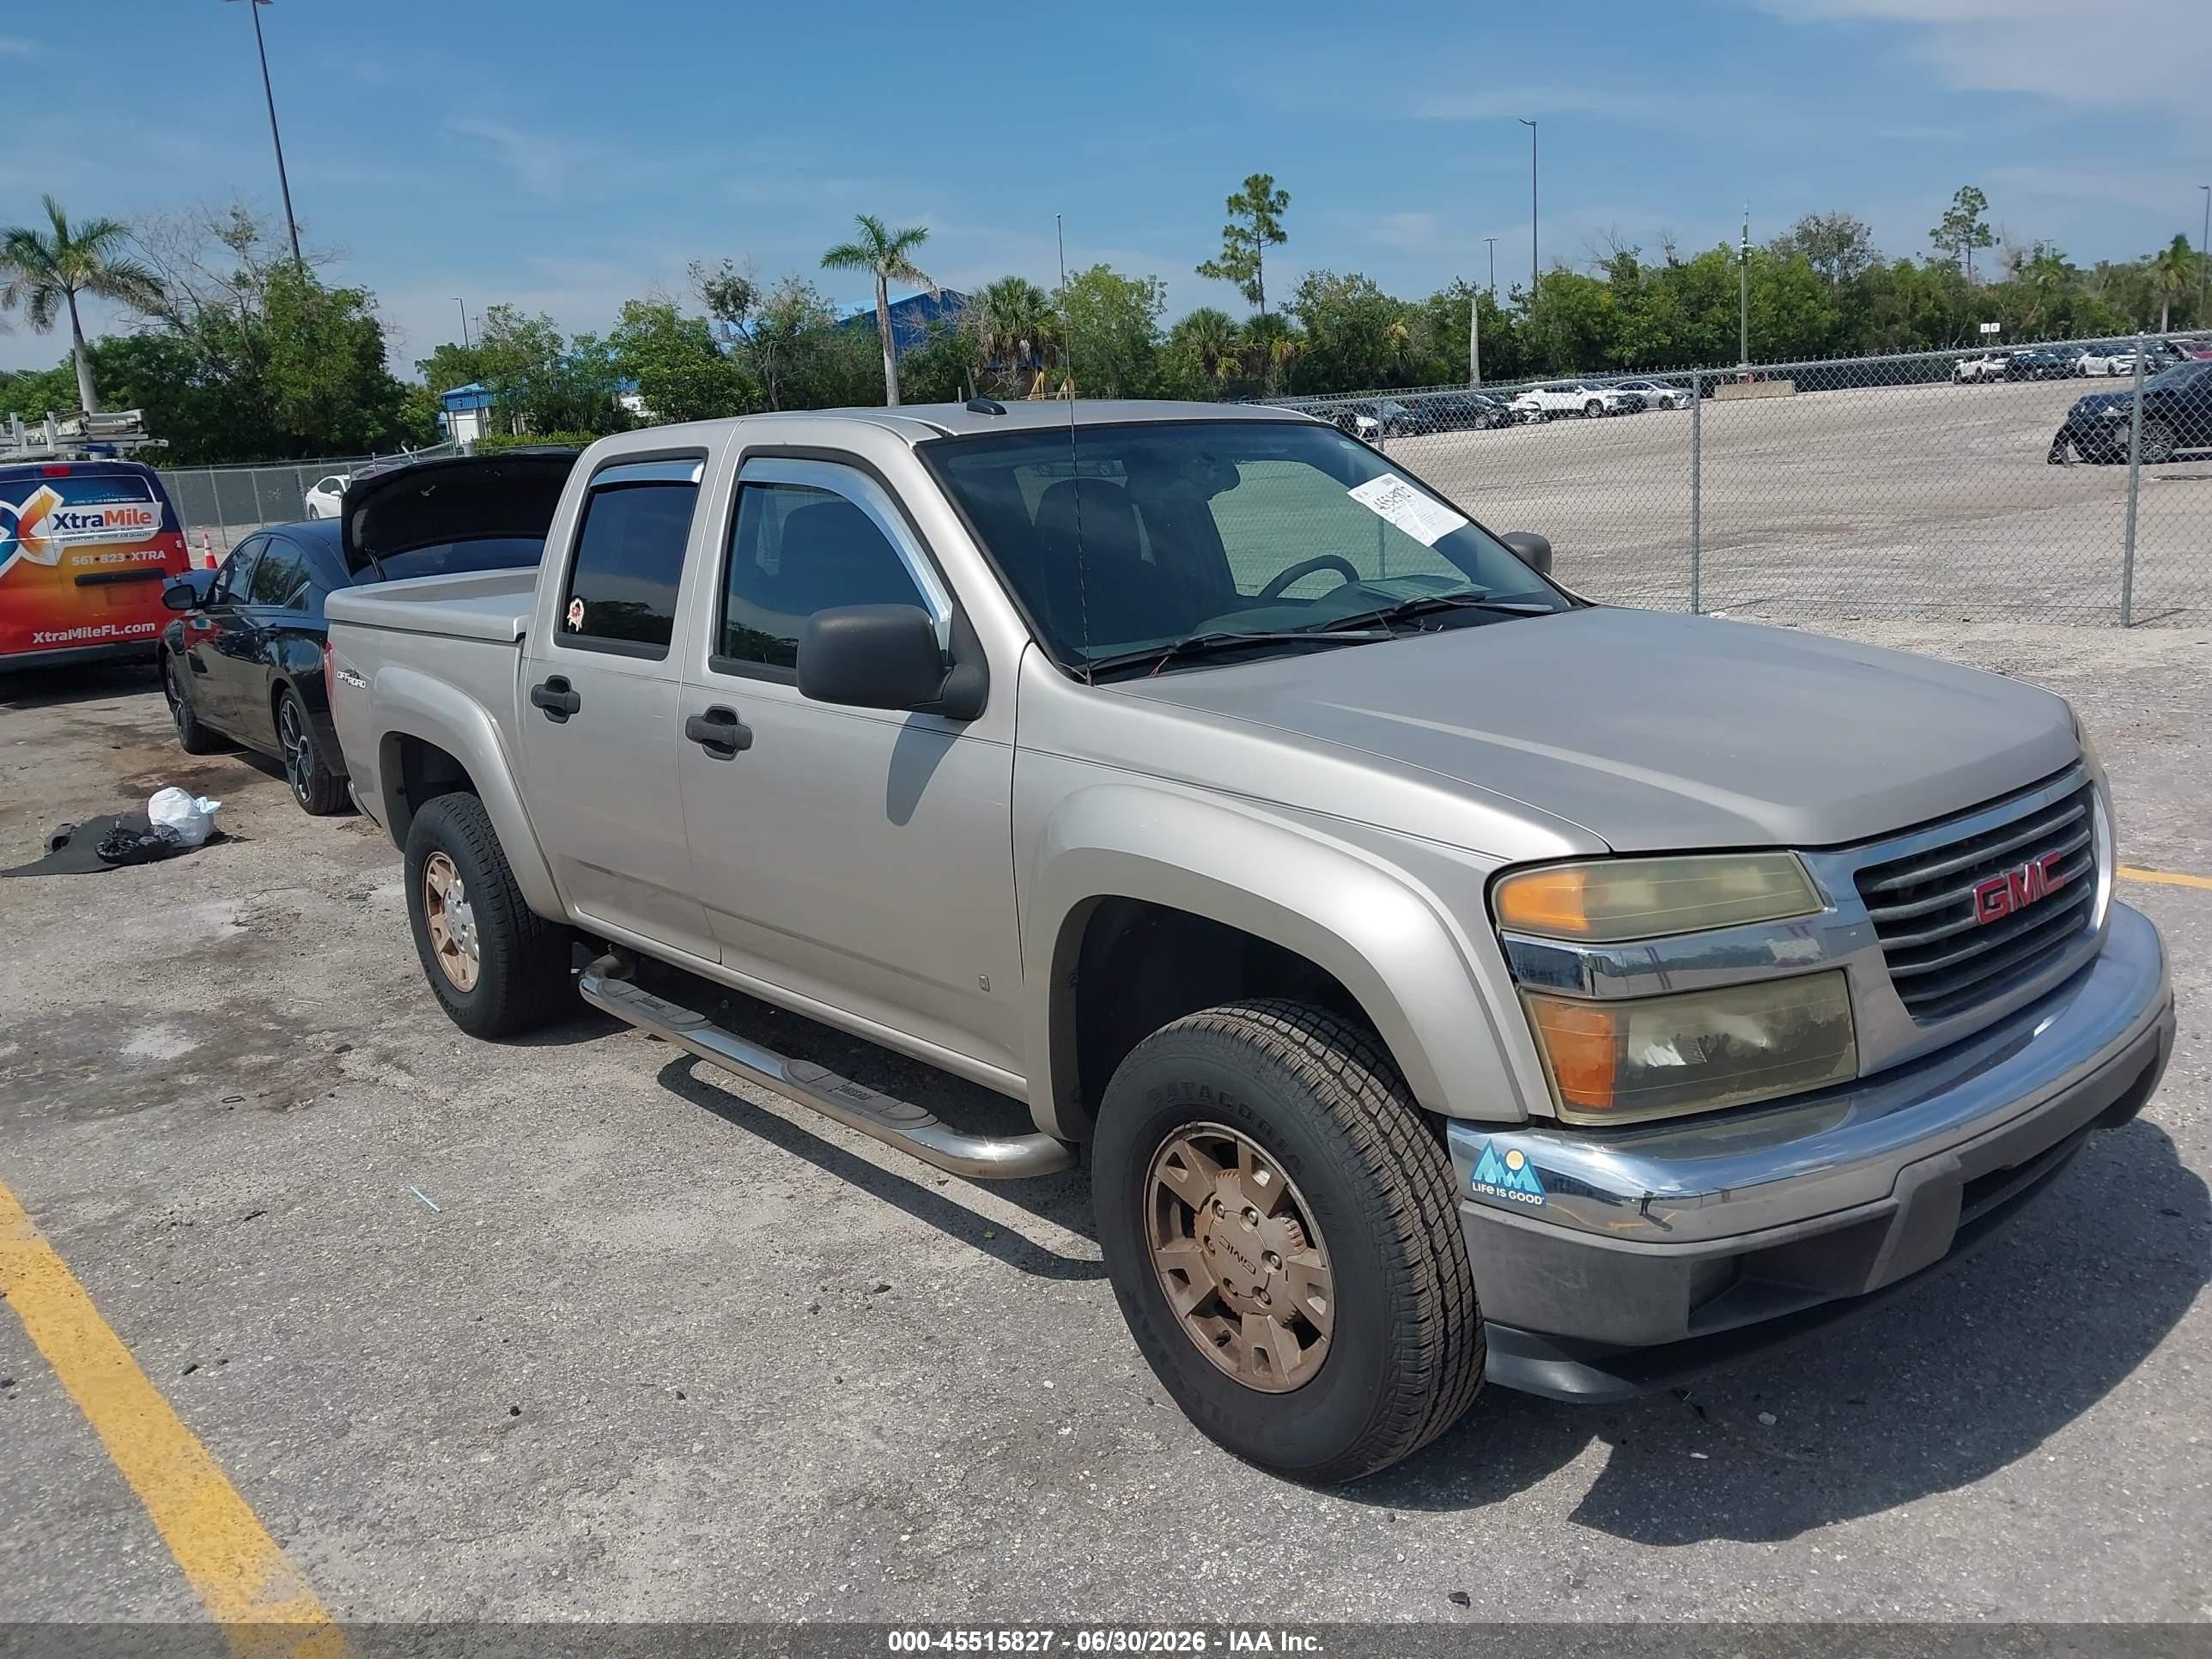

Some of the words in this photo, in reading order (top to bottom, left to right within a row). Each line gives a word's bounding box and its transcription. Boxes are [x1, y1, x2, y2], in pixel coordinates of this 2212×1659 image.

[52, 508, 152, 531] XtraMile
[33, 622, 155, 644] XtraMileFL.com
[1973, 848, 2064, 925] GMC
[1496, 1187, 1507, 1198] IS
[1218, 1235, 1257, 1276] GMC
